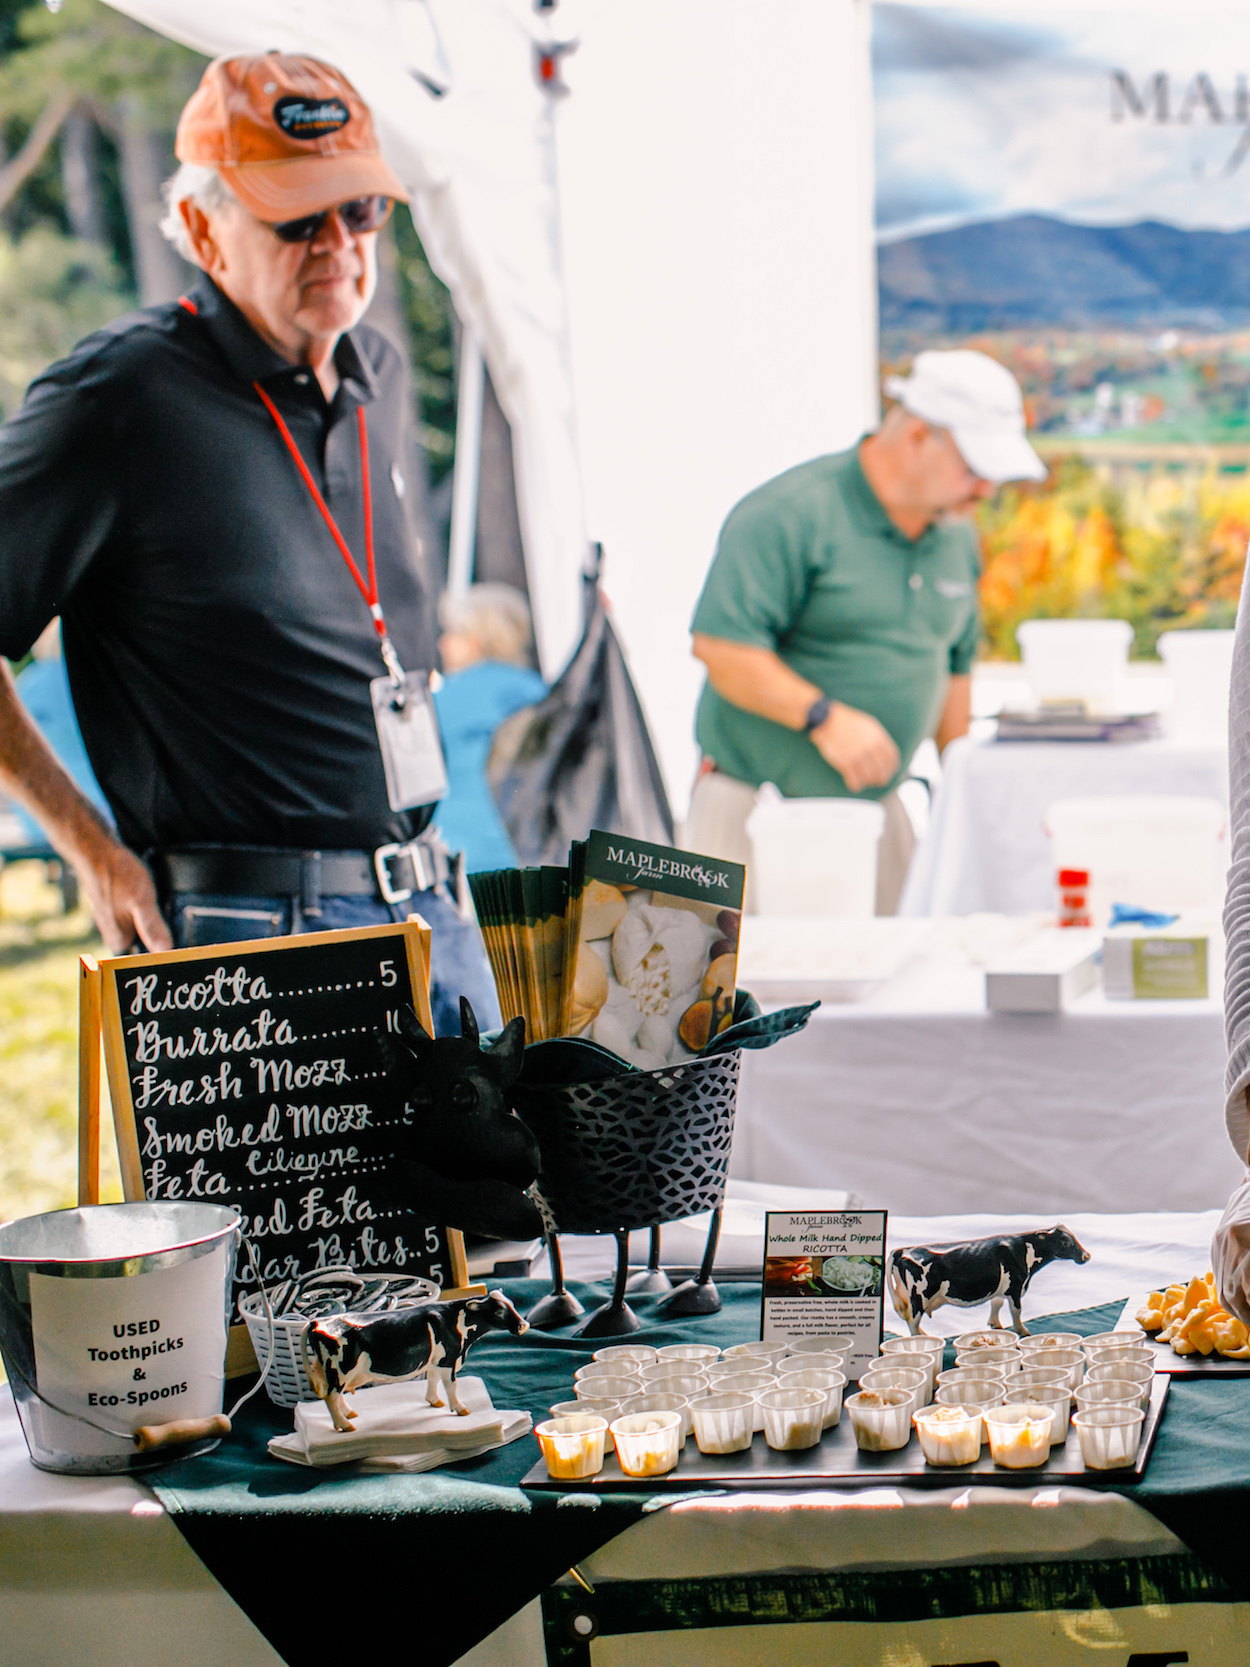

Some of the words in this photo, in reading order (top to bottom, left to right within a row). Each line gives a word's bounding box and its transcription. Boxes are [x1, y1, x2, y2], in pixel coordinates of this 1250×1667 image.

[606, 846, 729, 889] MAPLEBROOK
[626, 866, 663, 881] farm
[124, 966, 272, 1015] Ricotta
[379, 960, 397, 987] 5
[127, 1009, 298, 1063] Burrata
[132, 1061, 243, 1109] Fresh
[250, 1057, 351, 1094] Mozz
[141, 1104, 283, 1159] Smoked
[286, 1103, 374, 1139] Mozz
[144, 1158, 231, 1200] Feta
[299, 1185, 378, 1232] Feta
[790, 1215, 862, 1227] MAPLEBROOK
[308, 1225, 407, 1269] Bites
[424, 1226, 440, 1254] 5
[769, 1233, 796, 1243] Whole
[800, 1233, 819, 1242] Milk
[822, 1233, 847, 1242] Hand
[850, 1233, 883, 1244] Dipped
[803, 1244, 848, 1253] RICOTTA
[430, 1264, 444, 1287] 5
[113, 1319, 161, 1338] USED
[87, 1337, 184, 1361] Toothpicks
[132, 1367, 147, 1382] &
[87, 1381, 188, 1407] Eco-Spoons
